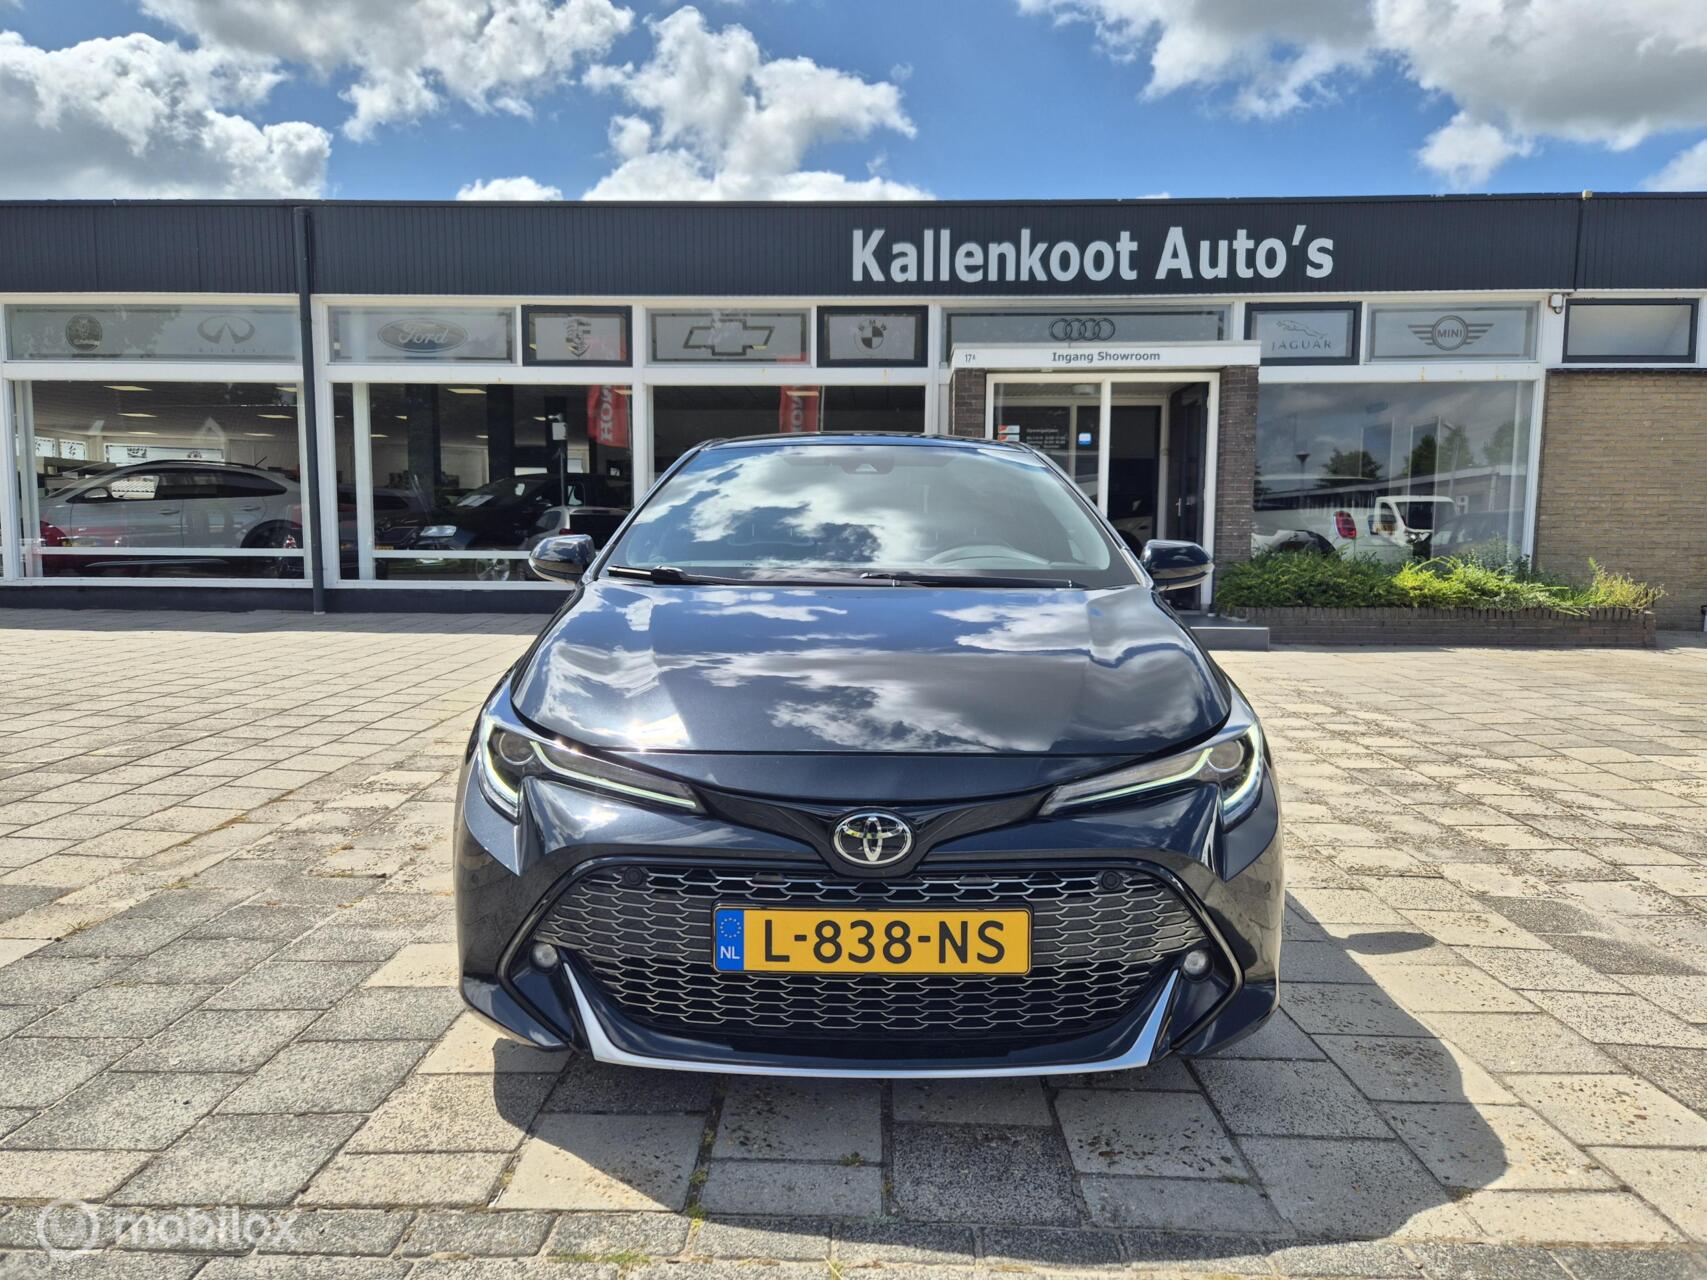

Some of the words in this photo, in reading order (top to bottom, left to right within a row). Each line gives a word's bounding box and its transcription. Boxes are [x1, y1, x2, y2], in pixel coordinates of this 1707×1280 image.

[851, 227, 1138, 283] Kallenkoot
[398, 323, 449, 344] Ford
[1437, 328, 1463, 338] MINI
[1271, 339, 1332, 351] JAGUAR
[1051, 351, 1094, 364] Ingang
[1097, 351, 1161, 361] Showroom
[764, 919, 1006, 964] L-838-NS
[719, 945, 741, 960] NL
